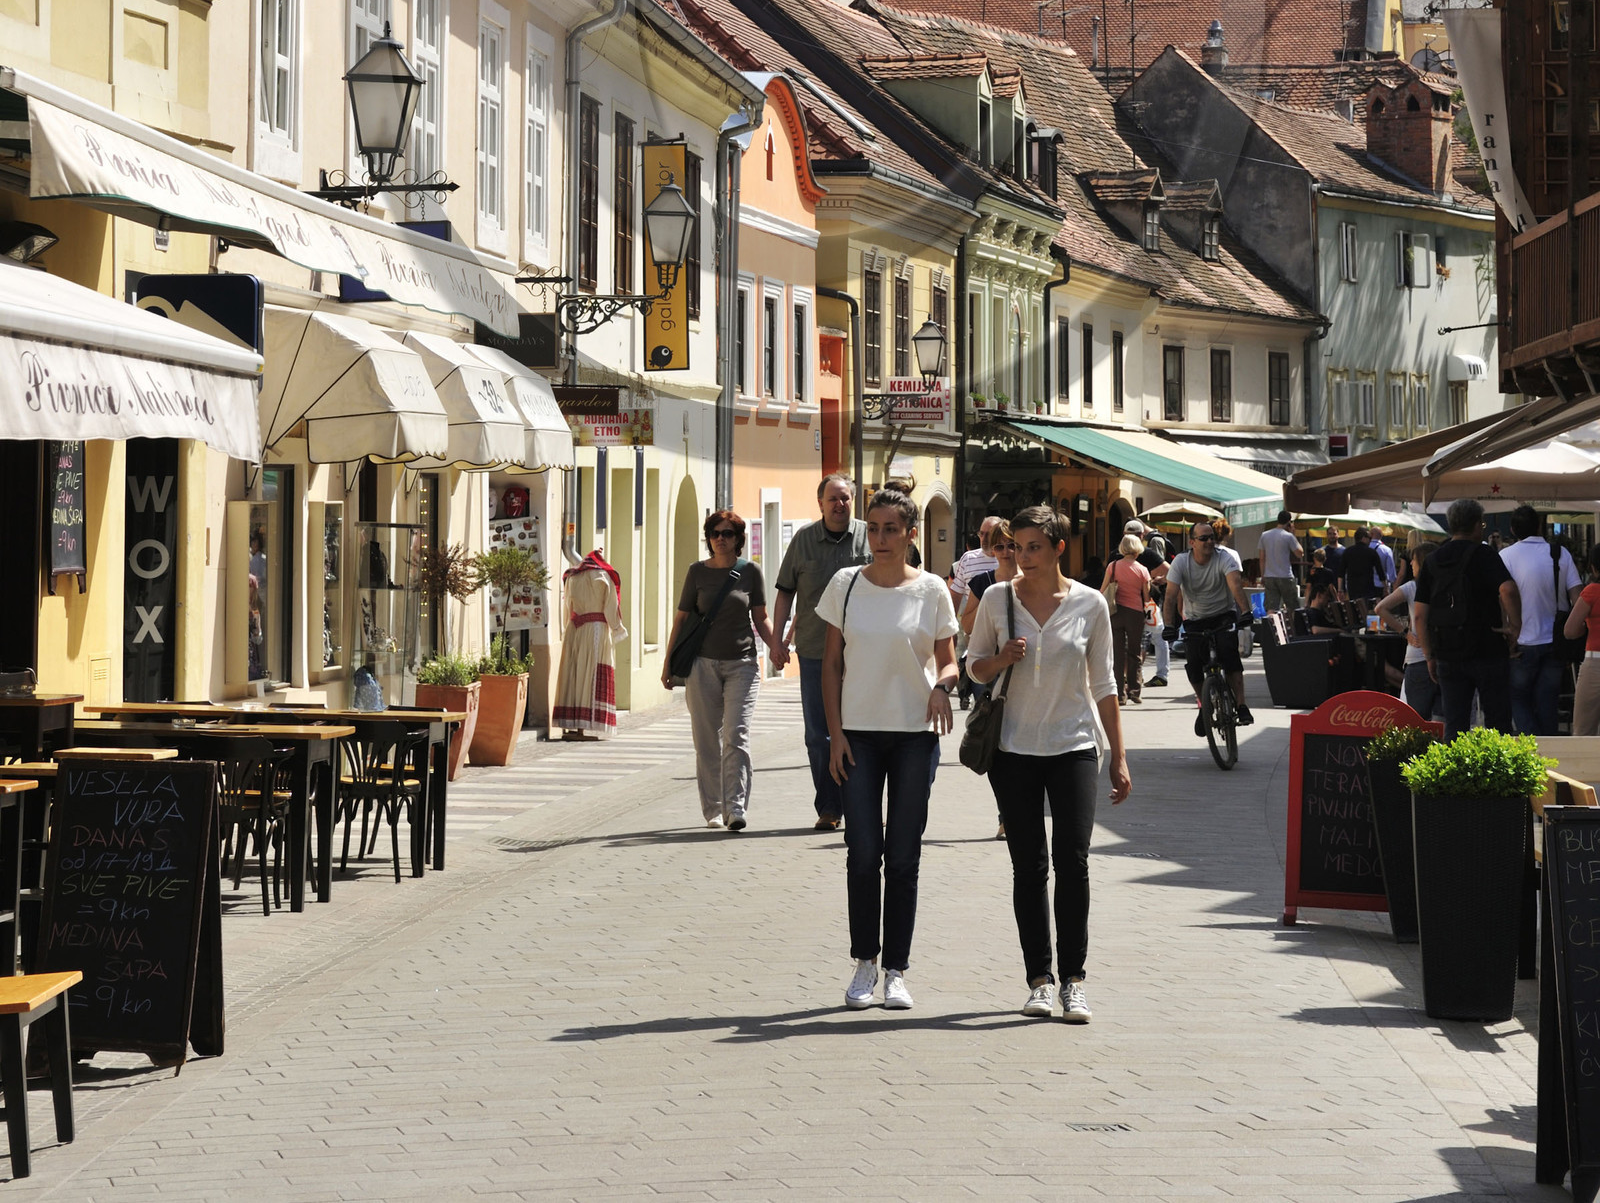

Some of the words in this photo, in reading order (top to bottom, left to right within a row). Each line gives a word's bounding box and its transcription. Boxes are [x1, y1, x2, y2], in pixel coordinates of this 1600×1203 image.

[488, 336, 545, 346] MONDAYS
[21, 350, 121, 415] Pivnica
[557, 394, 613, 408] garden
[890, 397, 943, 408] STINICA
[594, 426, 621, 437] ETNO
[128, 475, 173, 644] WOX
[68, 770, 179, 798] VESELA
[71, 824, 171, 851] DANAS
[1319, 825, 1372, 849] MALI
[60, 849, 86, 871] od
[62, 873, 116, 896] SVE
[122, 874, 189, 899] PIVE
[50, 922, 144, 952] MEDINA
[97, 954, 168, 983] ŠAPA
